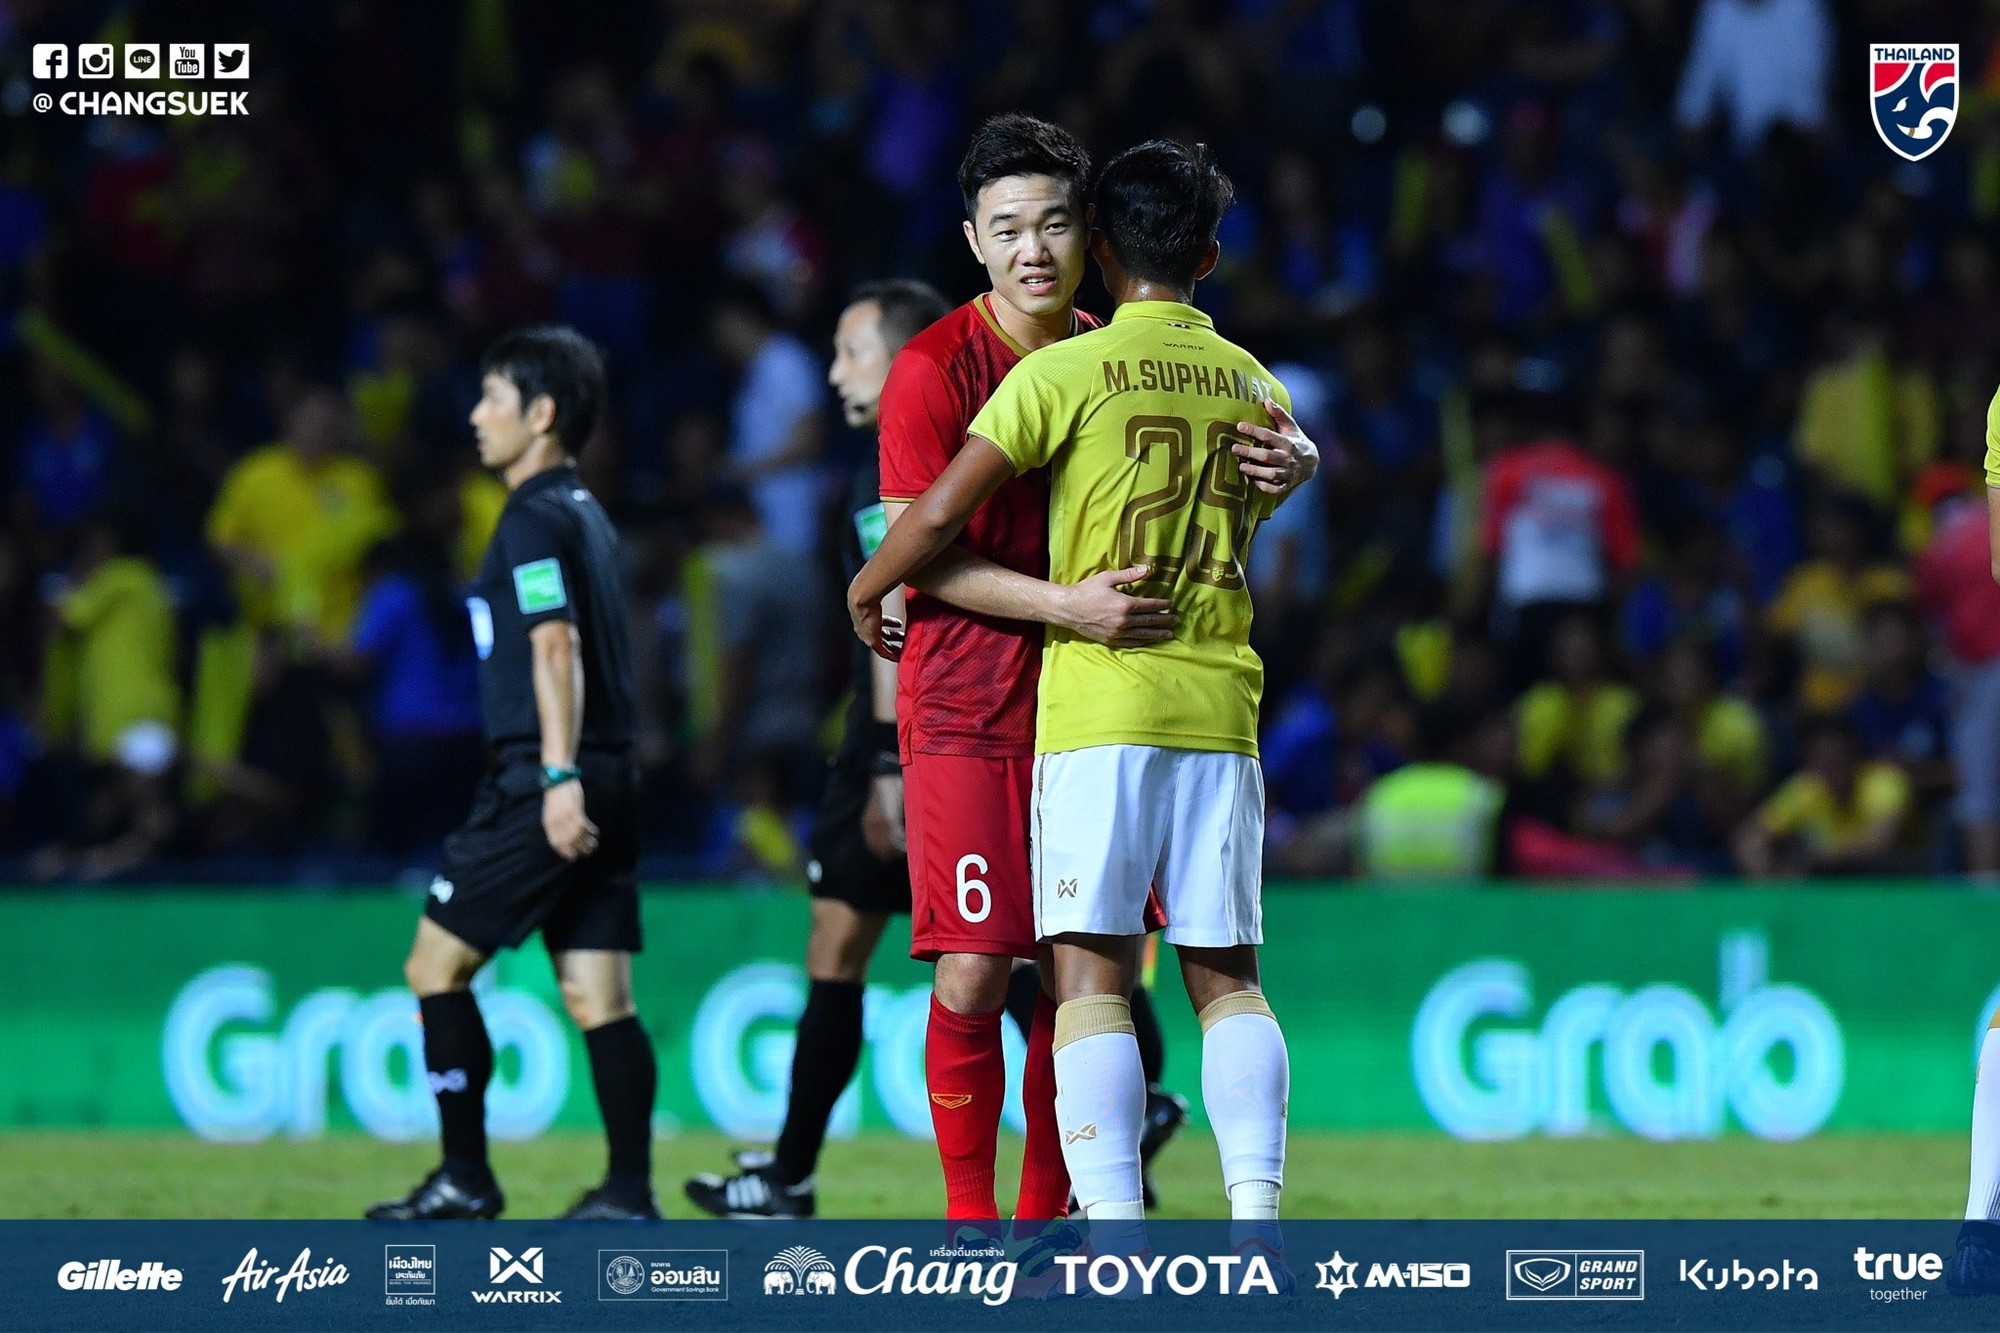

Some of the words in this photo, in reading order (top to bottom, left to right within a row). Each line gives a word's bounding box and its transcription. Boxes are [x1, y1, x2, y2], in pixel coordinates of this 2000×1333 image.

[1163, 342, 1204, 350] WARRIX
[1118, 415, 1264, 590] 29
[956, 854, 992, 923] 6
[162, 957, 570, 1142] Grab
[1411, 929, 1844, 1141] Grab
